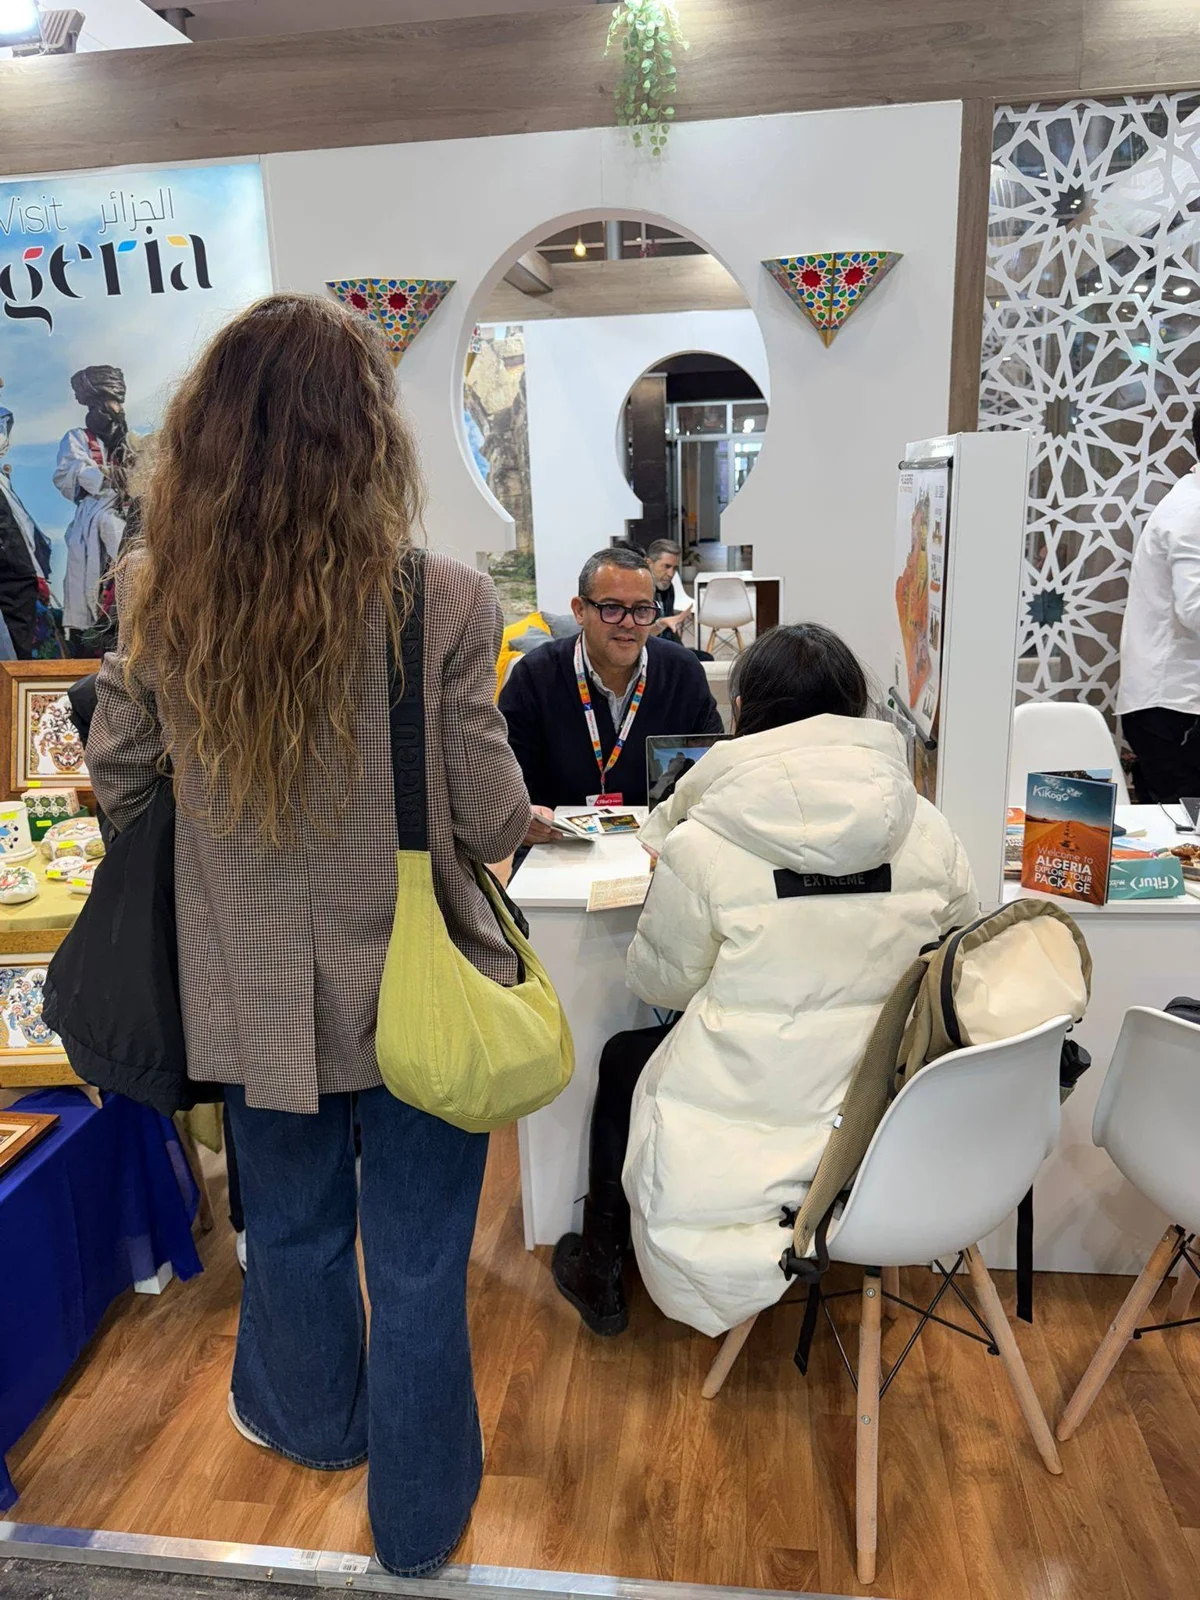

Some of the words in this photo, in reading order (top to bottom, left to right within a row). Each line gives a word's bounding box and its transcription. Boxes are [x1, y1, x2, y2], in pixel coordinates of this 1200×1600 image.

[0, 196, 67, 235] Visit
[98, 187, 175, 235] الجزائر
[0, 225, 213, 337] geria
[1035, 855, 1093, 876] ALGERIA
[1038, 846, 1080, 862] Welcome
[1083, 856, 1094, 865] to
[803, 874, 865, 887] EXTREME
[1034, 864, 1067, 879] EXPLORE
[1069, 871, 1093, 884] TOUR
[1034, 872, 1091, 895] PACKAGE
[1138, 876, 1169, 890] Fitur
